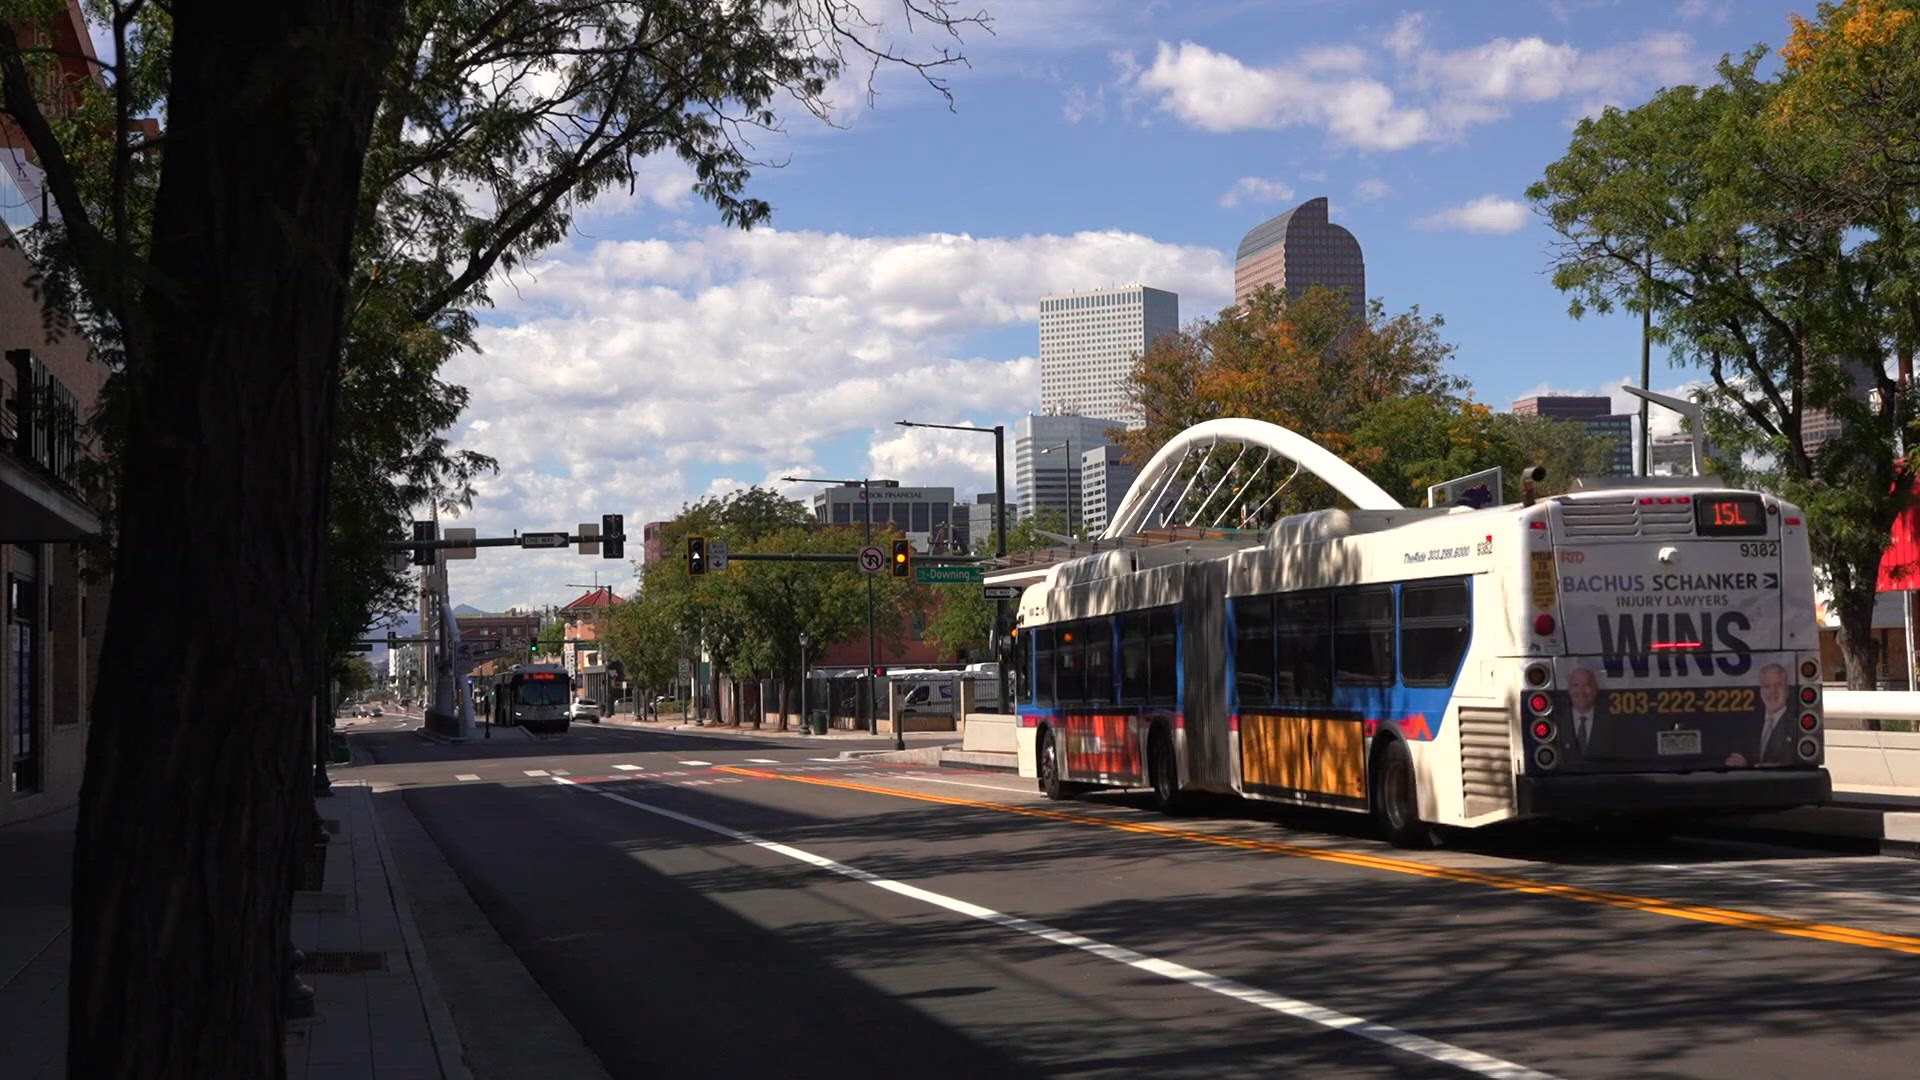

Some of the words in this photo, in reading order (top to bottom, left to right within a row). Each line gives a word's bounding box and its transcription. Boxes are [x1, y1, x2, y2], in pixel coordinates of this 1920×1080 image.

[884, 490, 923, 499] FINANCIAL
[1714, 502, 1747, 526] 15L
[526, 537, 539, 545] ONE
[541, 536, 554, 544] WAY
[1476, 541, 1493, 556] 9382
[1740, 543, 1778, 558] 9382
[1560, 551, 1585, 564] RTD
[930, 568, 970, 581] Downing
[1563, 574, 1645, 593] BACHUS
[1652, 572, 1758, 591] SCHANKER
[1616, 595, 1662, 608] INJURY
[1666, 594, 1729, 607] LAWYERS
[1597, 611, 1752, 678] WINS
[1609, 689, 1755, 715] 303-222-2222
